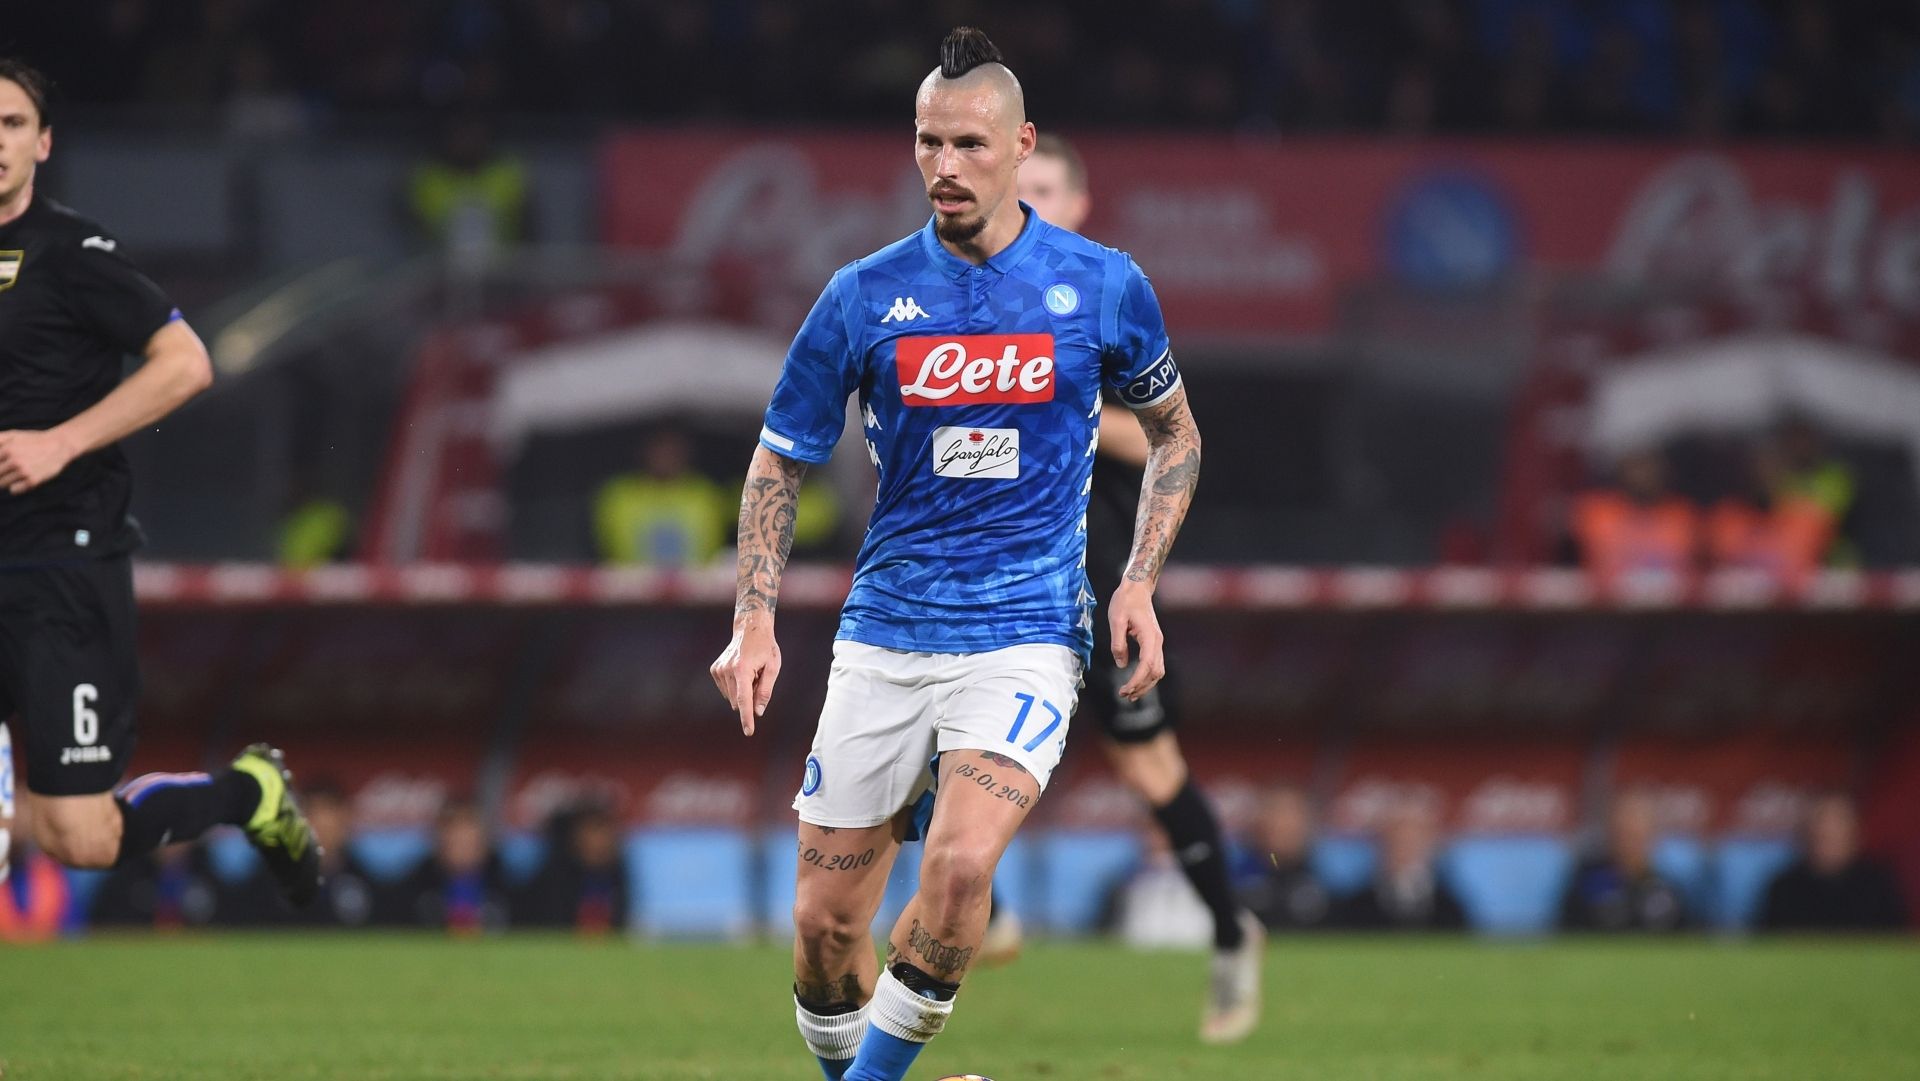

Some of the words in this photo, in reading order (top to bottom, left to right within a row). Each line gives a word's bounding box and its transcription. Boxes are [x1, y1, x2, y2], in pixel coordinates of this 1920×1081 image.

[1053, 290, 1070, 309] N
[900, 342, 1054, 400] Lete
[934, 434, 1019, 476] Garofalo
[73, 683, 98, 746] 6
[1006, 692, 1062, 753] 17
[955, 763, 1030, 809] 05.01.2012
